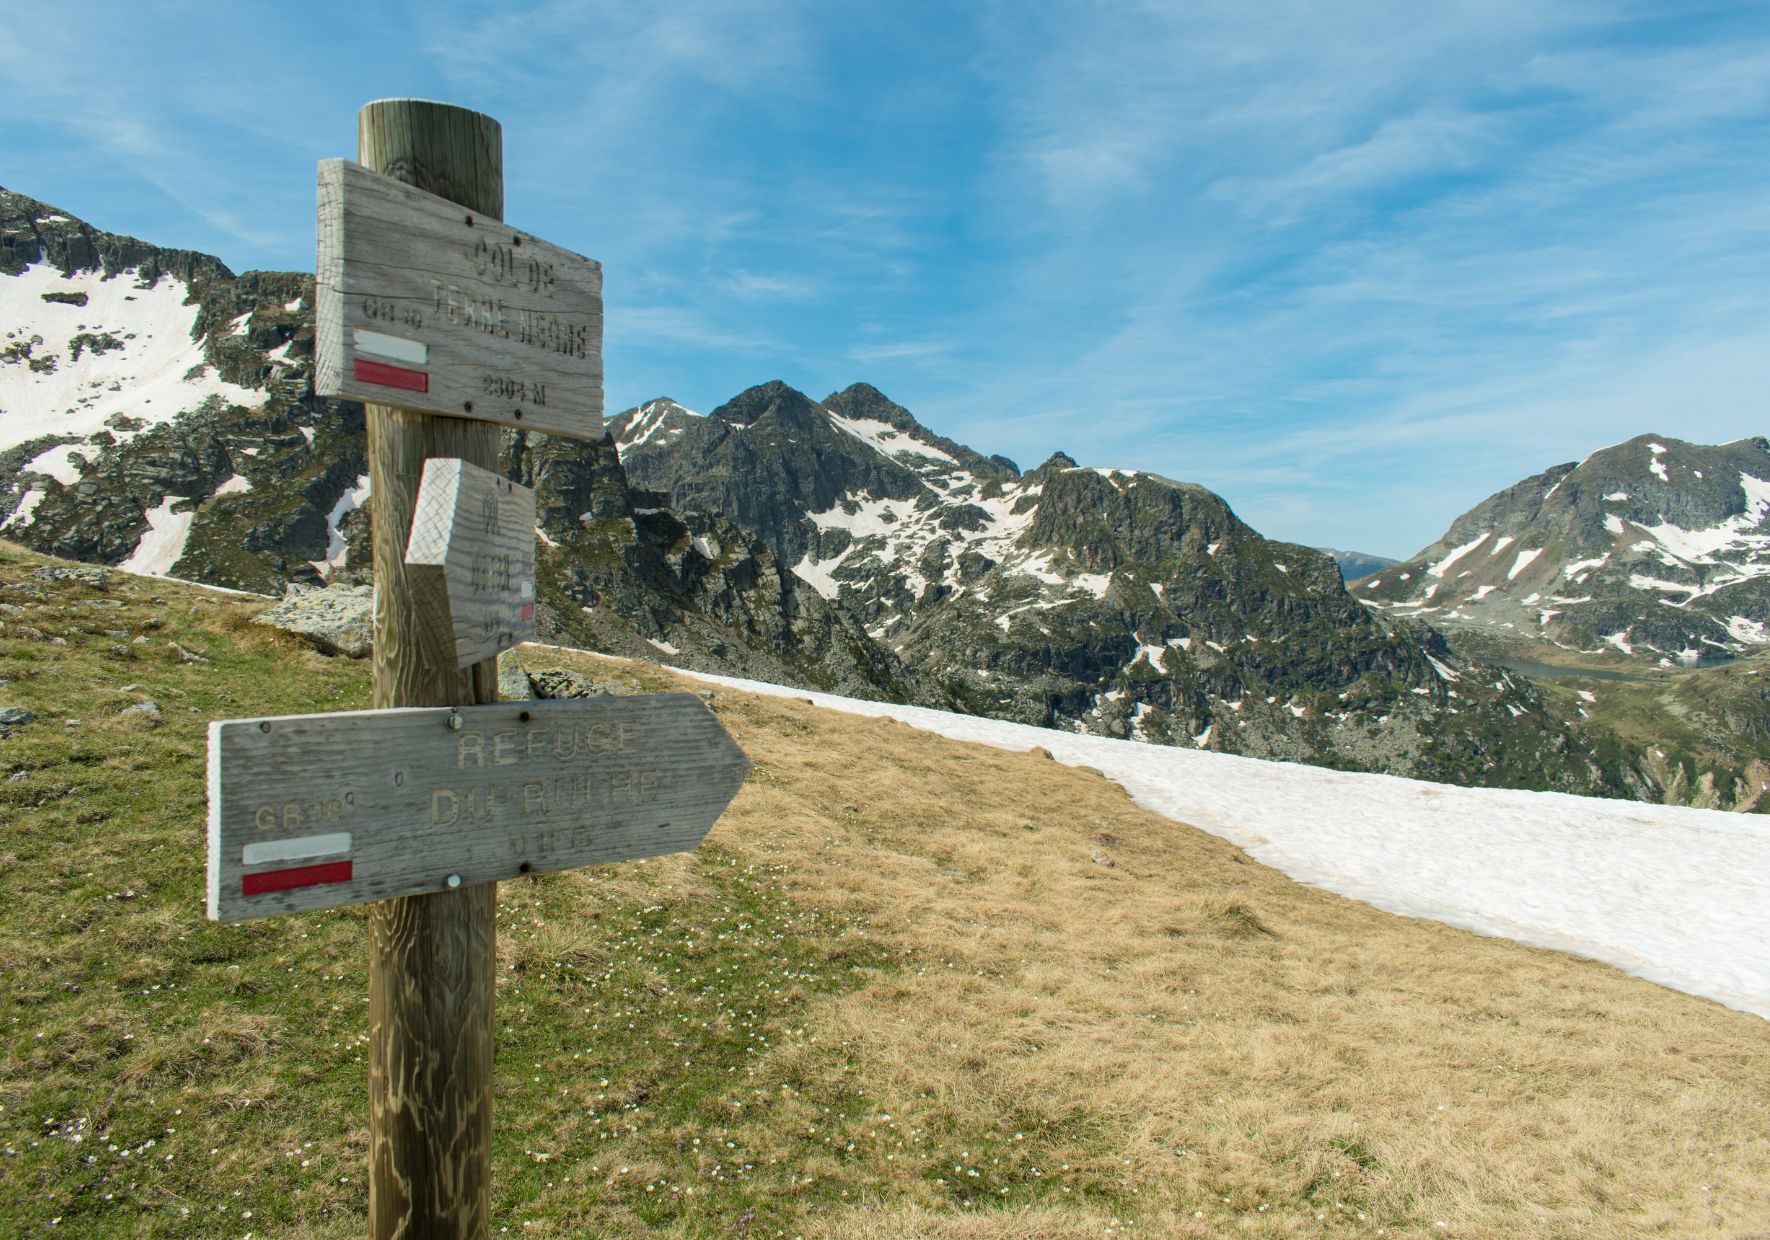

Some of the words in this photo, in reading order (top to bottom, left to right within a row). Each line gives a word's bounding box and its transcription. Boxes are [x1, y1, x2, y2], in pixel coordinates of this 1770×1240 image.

[473, 237, 518, 288] COL
[456, 718, 641, 769] REFUGE
[255, 800, 302, 831] GR
[316, 799, 343, 825] 10
[432, 783, 496, 828] DU
